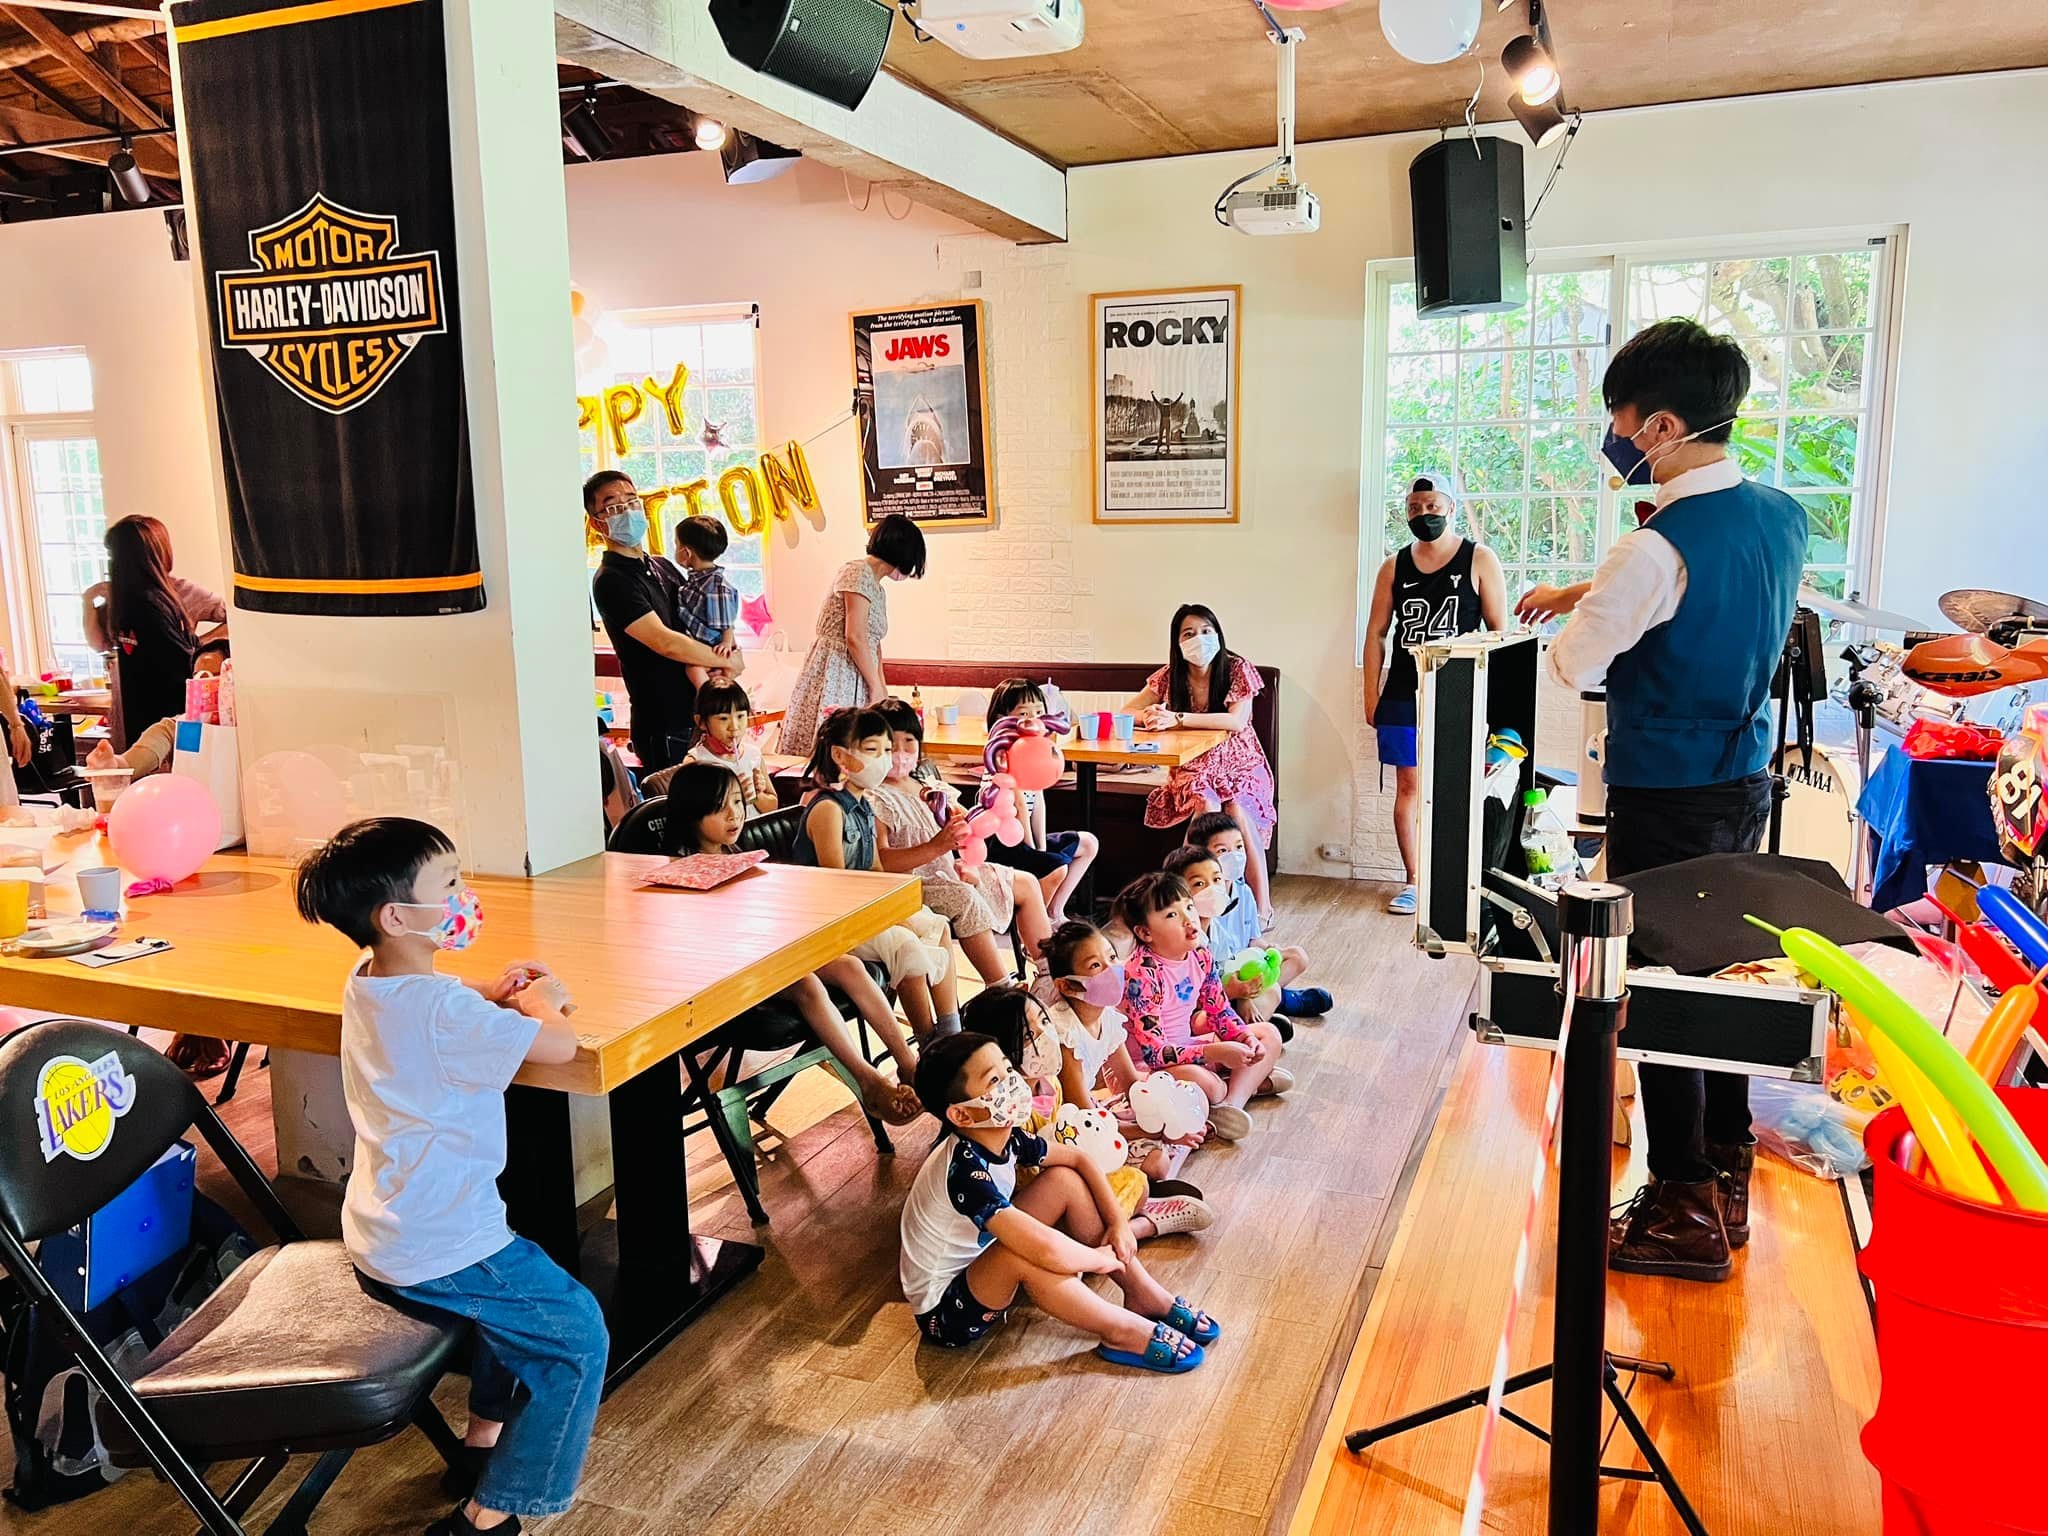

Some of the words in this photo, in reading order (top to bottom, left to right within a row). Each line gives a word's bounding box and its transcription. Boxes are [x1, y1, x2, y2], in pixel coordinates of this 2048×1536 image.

[274, 217, 374, 269] MOTOR
[234, 273, 426, 329] HARLEY-DAVIDSON
[885, 333, 950, 361] JAWS
[1105, 315, 1228, 348] ROCKY
[282, 336, 384, 395] CYCLES
[1401, 595, 1460, 649] 24
[1796, 764, 1832, 793] TAMA
[43, 1071, 127, 1151] LAKERS
[55, 1085, 70, 1100] LOS
